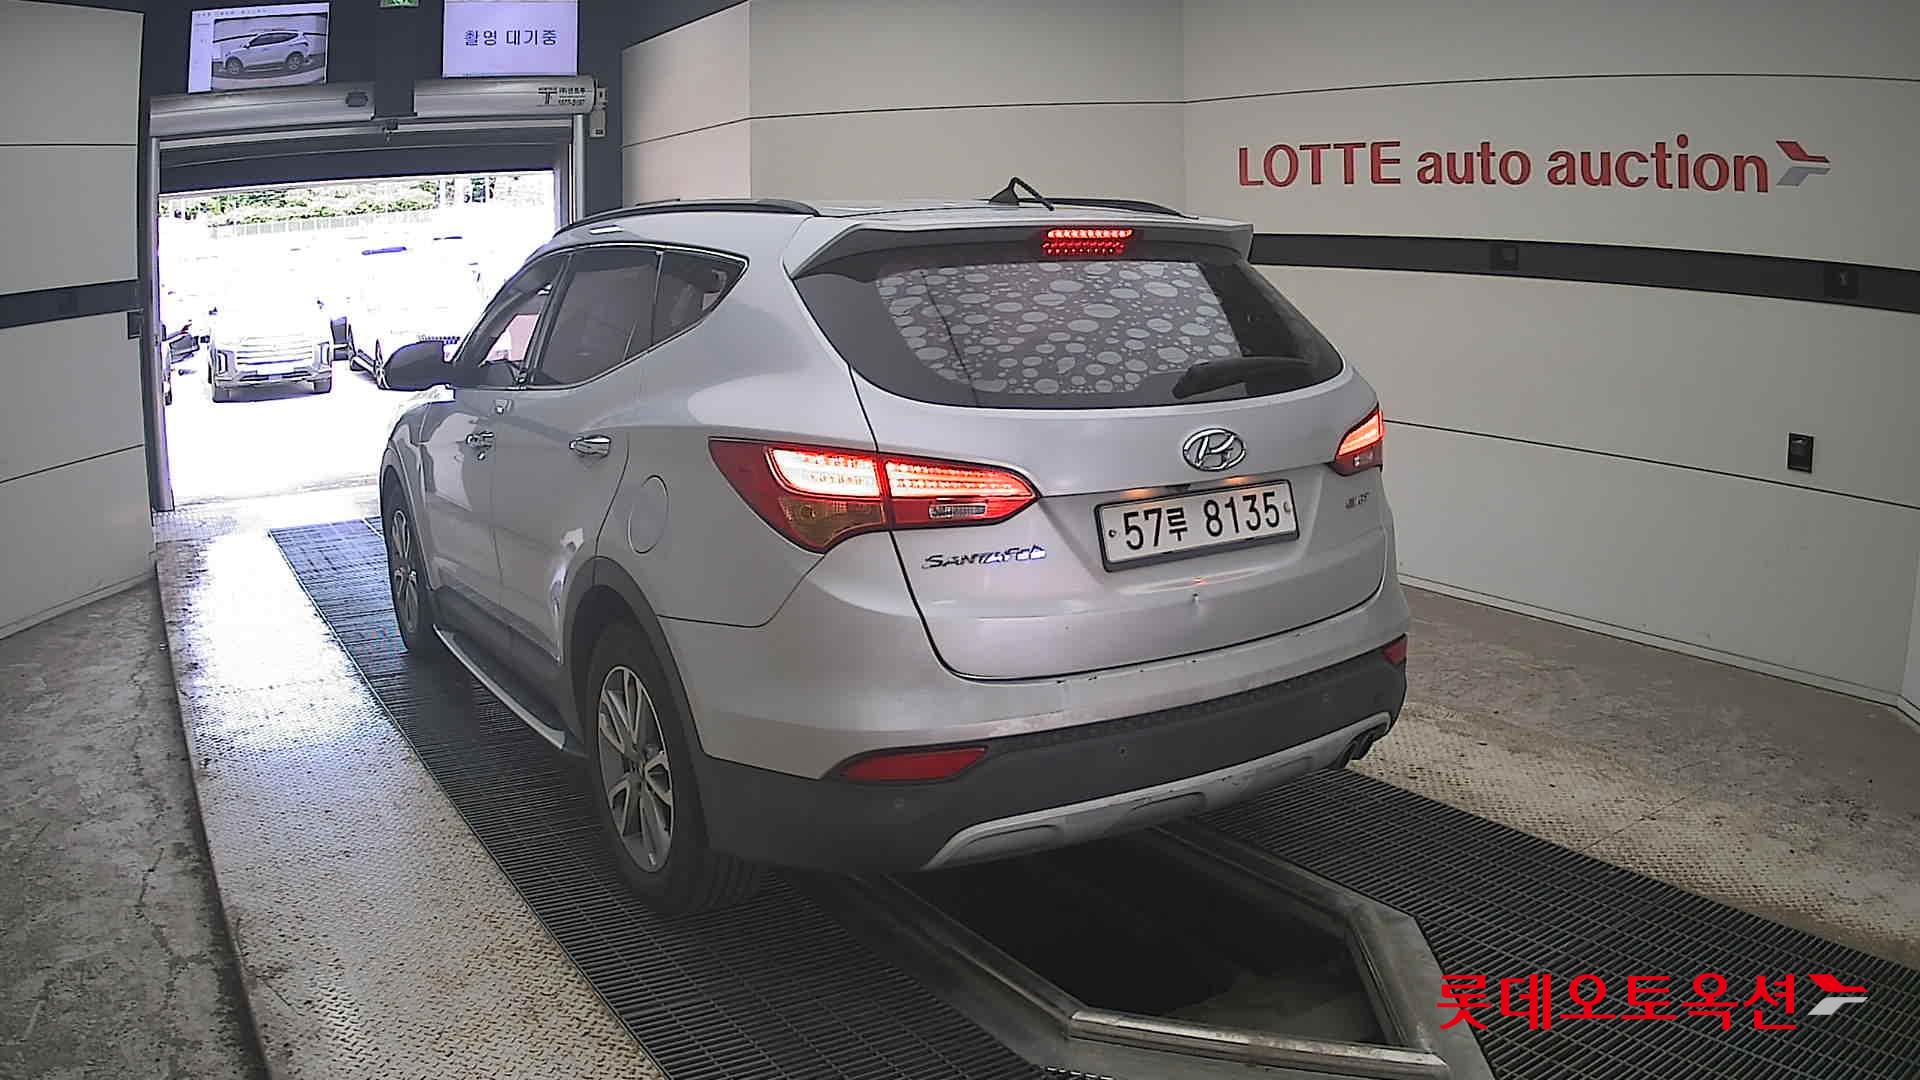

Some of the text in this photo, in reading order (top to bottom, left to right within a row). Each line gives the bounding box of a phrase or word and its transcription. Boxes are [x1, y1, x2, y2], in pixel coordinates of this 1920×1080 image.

[505, 29, 558, 46] 대기중
[1239, 134, 1769, 192] LOTTE auto auction
[1203, 491, 1280, 537] 8135
